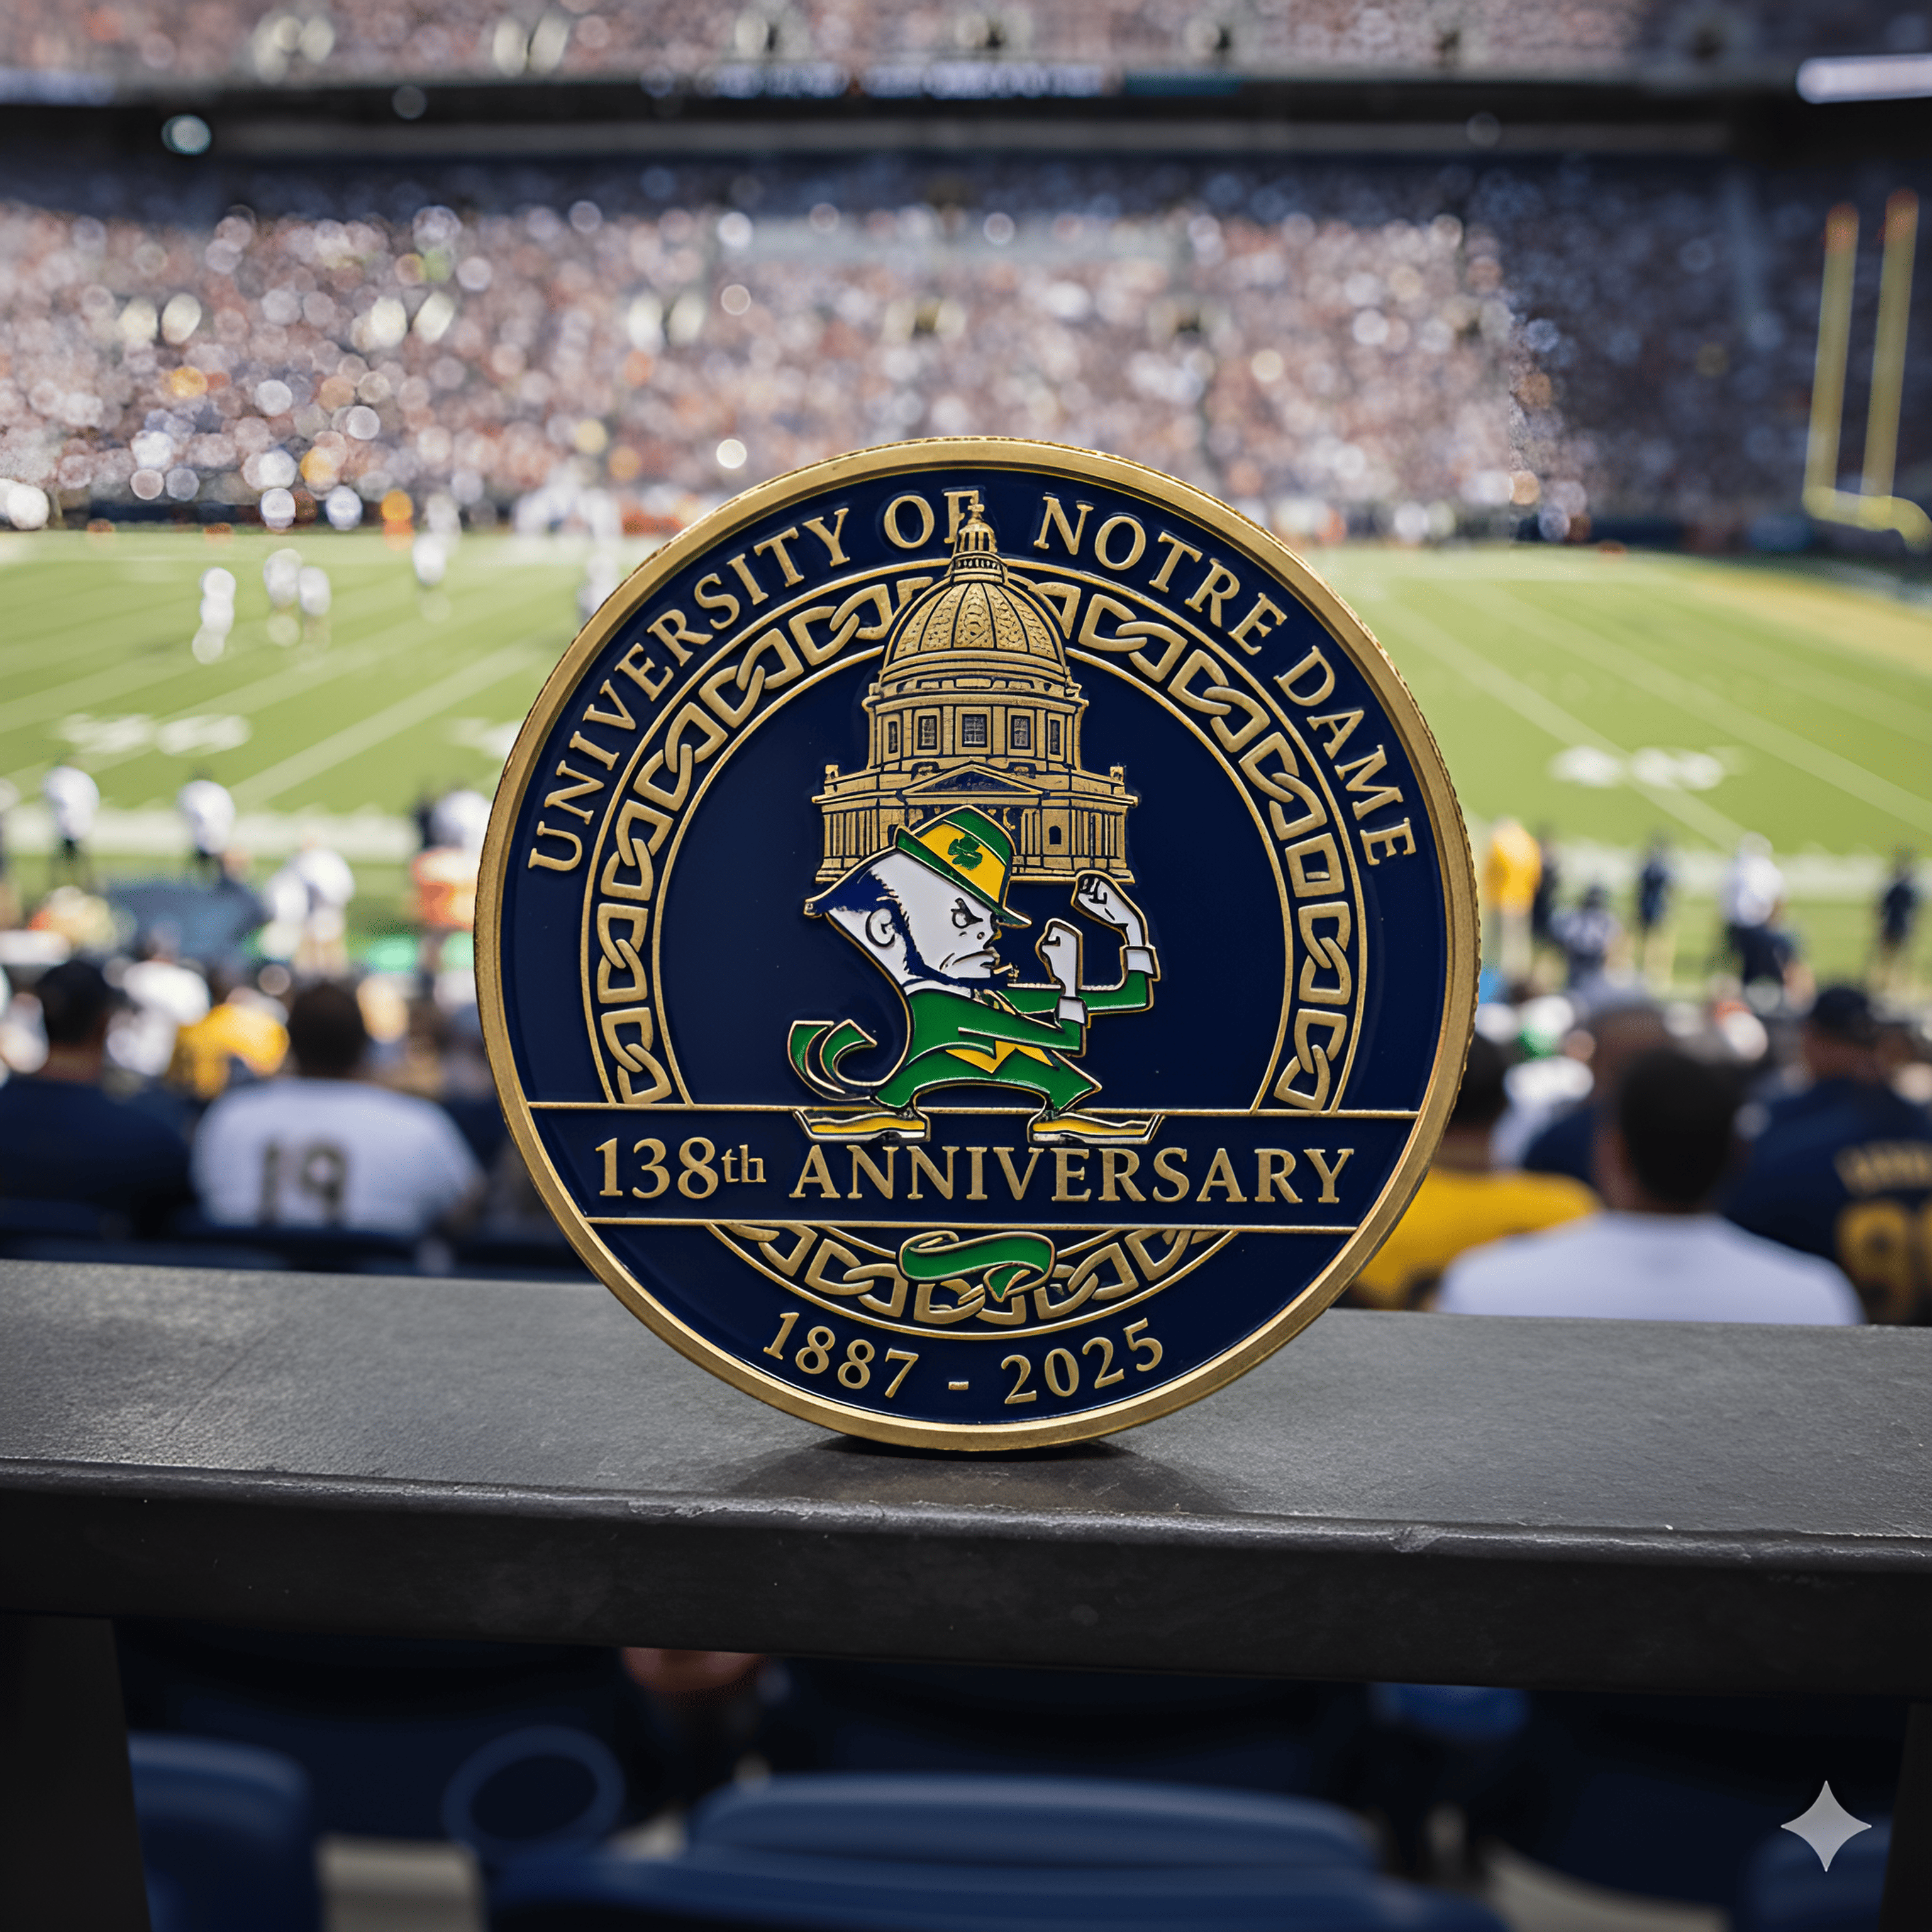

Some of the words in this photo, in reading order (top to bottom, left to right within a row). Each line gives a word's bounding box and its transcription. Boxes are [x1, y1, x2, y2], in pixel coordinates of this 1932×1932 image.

[528, 507, 851, 872] UNIVERSITY
[883, 490, 980, 549] OF
[1033, 495, 1288, 655] NOTRE
[1274, 645, 1417, 866] DAME
[595, 1136, 767, 1199] 138th
[788, 1145, 1355, 1204] ANNIVERSARY
[762, 1312, 919, 1398] 1887
[948, 1380, 969, 1390] -
[1001, 1318, 1163, 1404] 2025
